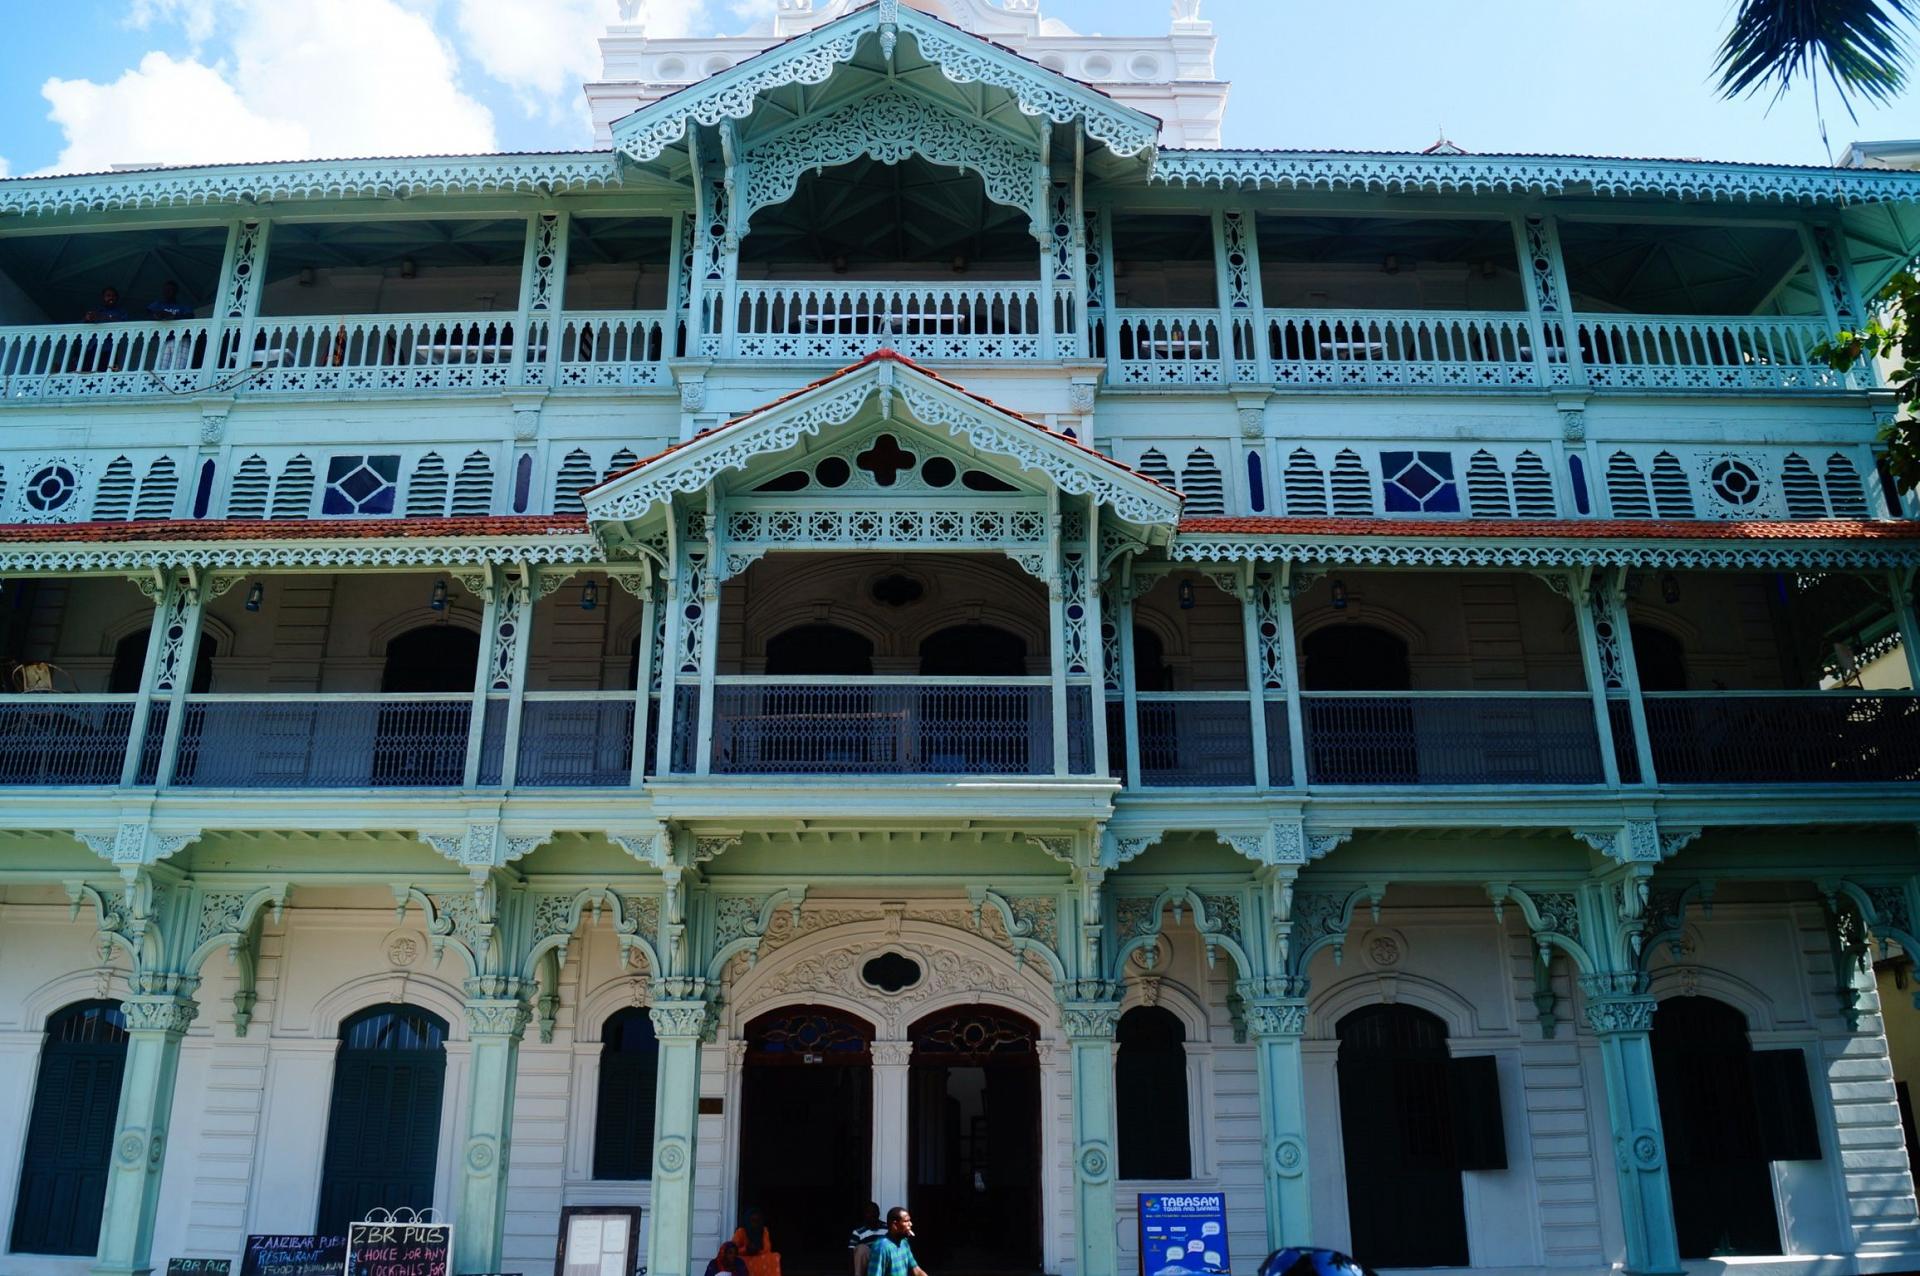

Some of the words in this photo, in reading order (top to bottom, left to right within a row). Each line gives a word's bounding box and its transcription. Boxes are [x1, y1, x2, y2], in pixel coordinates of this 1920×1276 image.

[1161, 1197, 1219, 1206] TABASAM
[353, 1226, 397, 1244] ZBR
[403, 1226, 444, 1244] PUB
[251, 1236, 315, 1249] ZANZIBAR
[258, 1249, 324, 1264] RESTAURANT
[357, 1247, 398, 1262] CHOICE
[424, 1247, 446, 1261] ANY
[169, 1258, 201, 1272] ZBR
